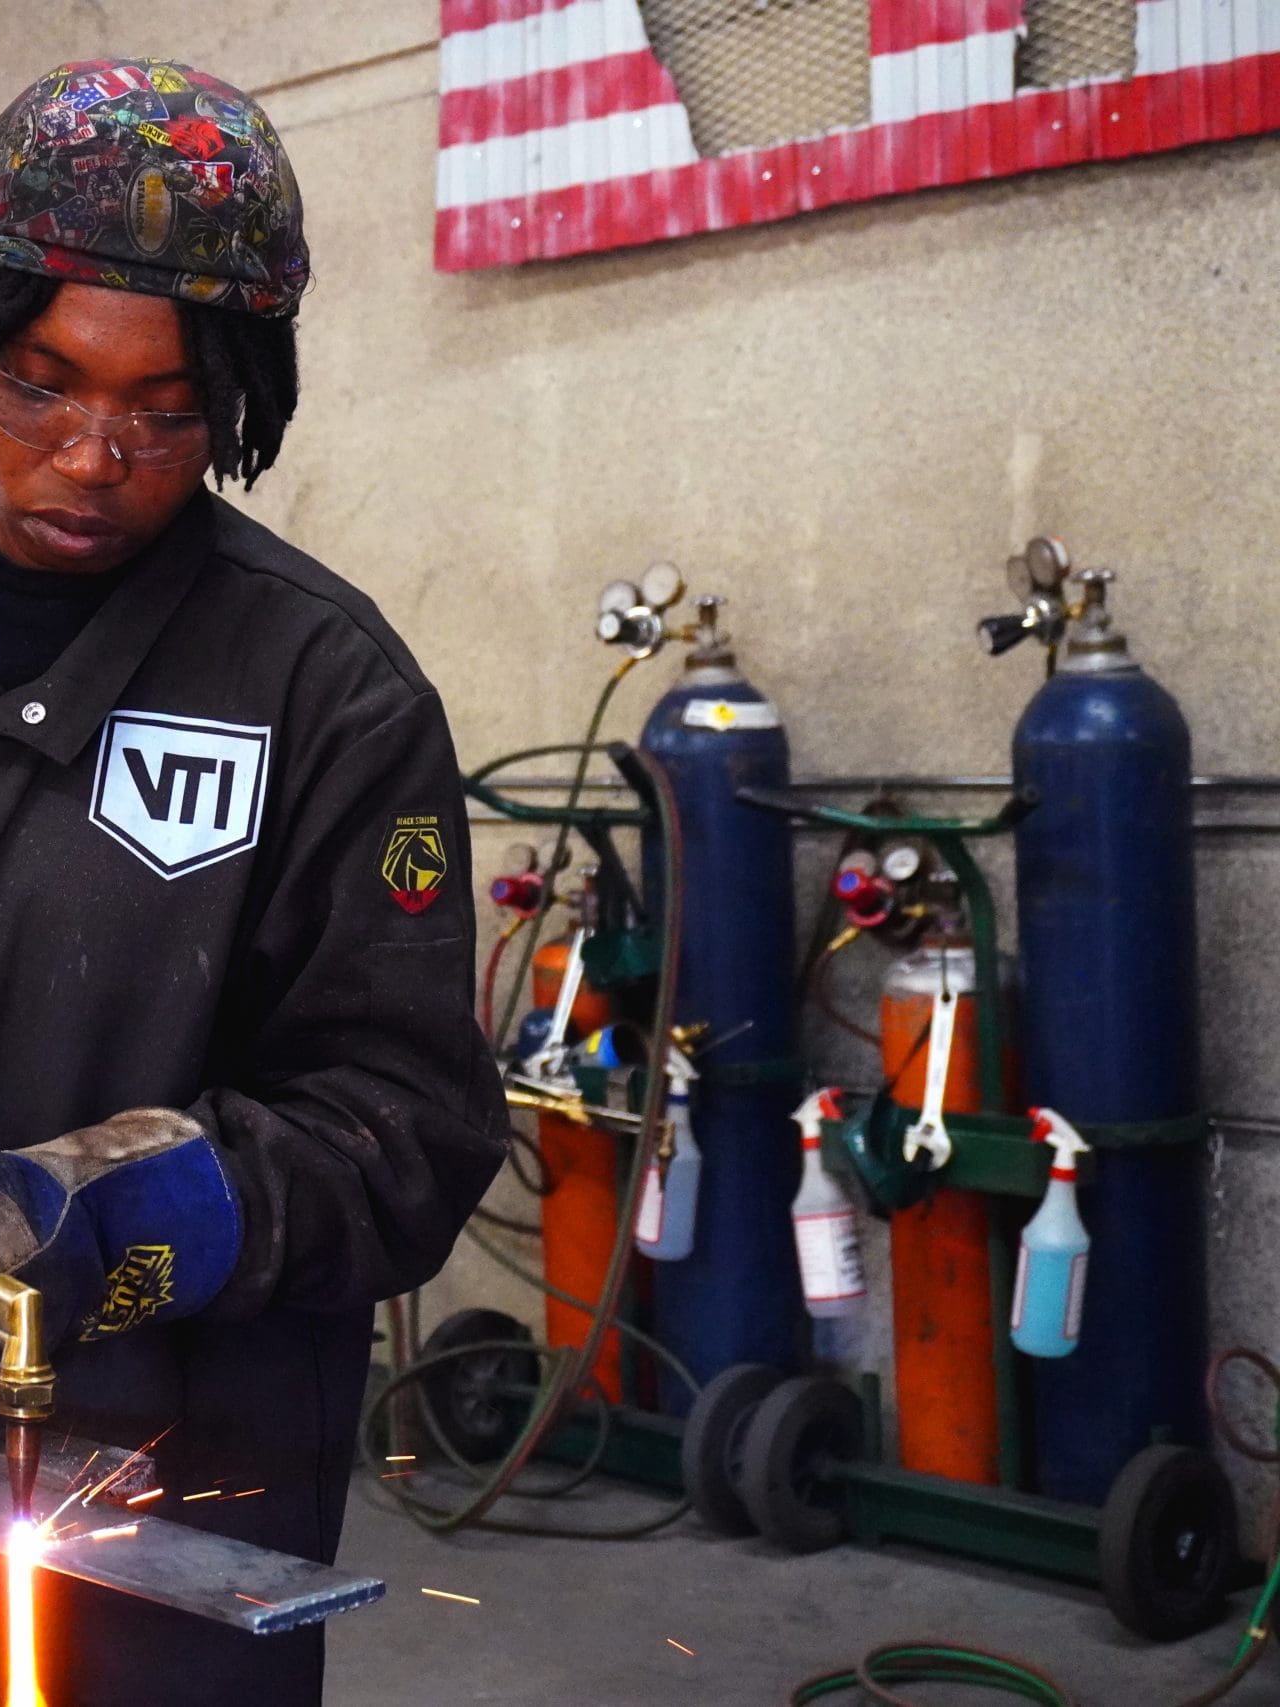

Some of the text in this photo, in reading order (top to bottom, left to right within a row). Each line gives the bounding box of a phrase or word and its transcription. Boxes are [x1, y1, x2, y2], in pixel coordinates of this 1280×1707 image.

[121, 746, 236, 831] VTI
[396, 815, 438, 826] BLACK STALLION
